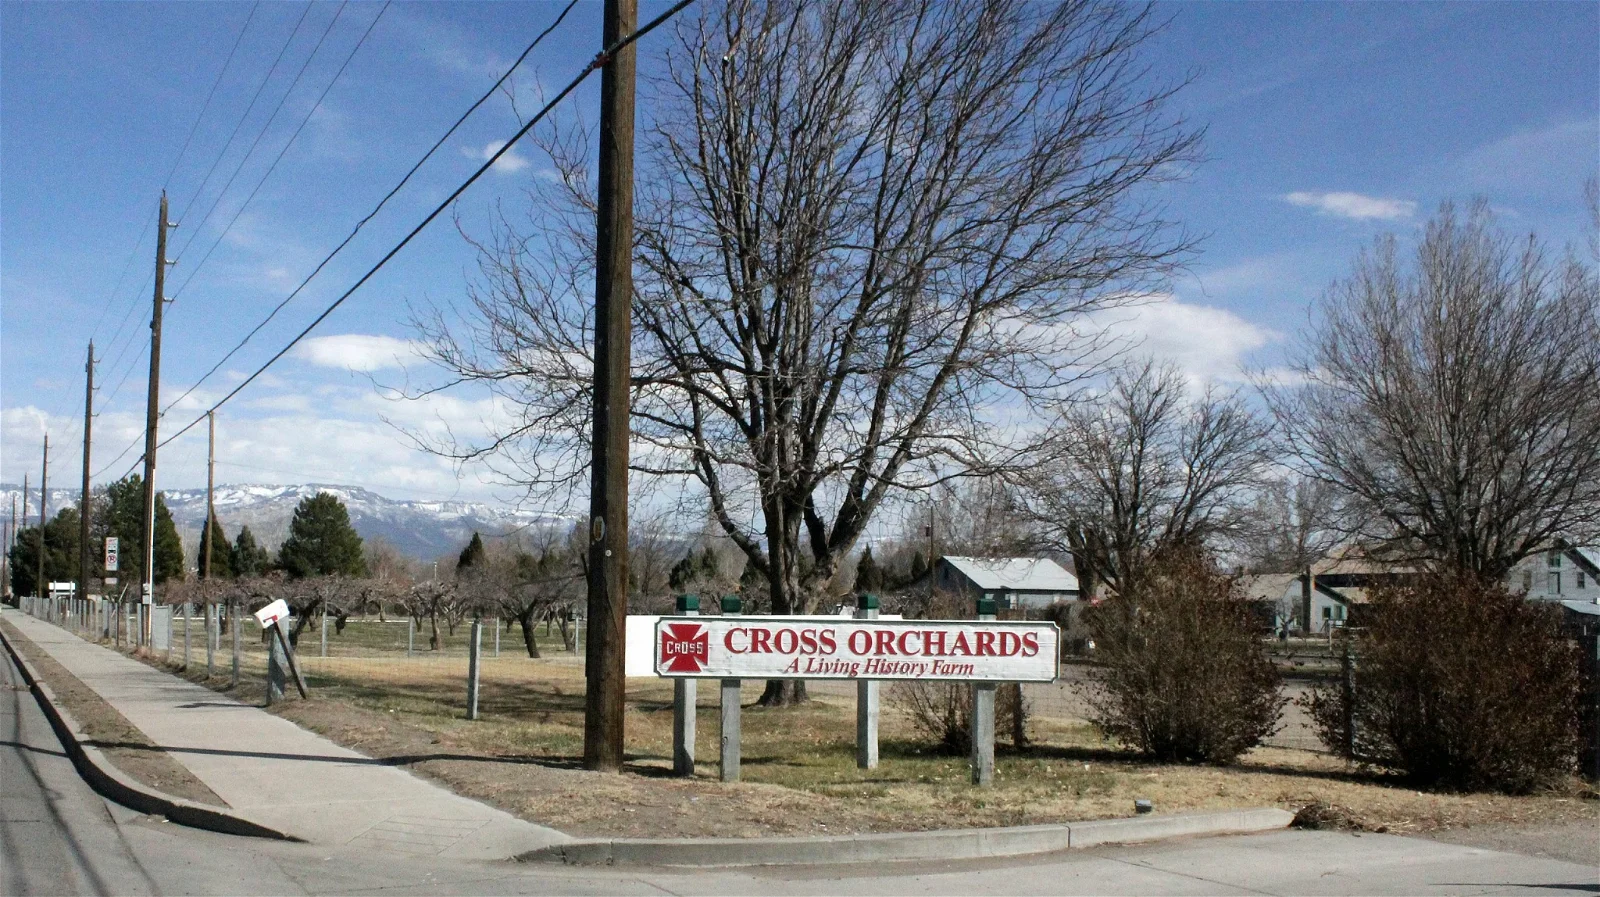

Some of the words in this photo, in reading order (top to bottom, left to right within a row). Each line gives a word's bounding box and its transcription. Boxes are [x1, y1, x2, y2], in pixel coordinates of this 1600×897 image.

[667, 641, 703, 654] CROSS
[724, 627, 837, 655] CROSS
[848, 629, 1039, 657] ORCHARDS
[785, 657, 799, 673] A
[804, 658, 859, 677] Living
[863, 658, 928, 677] History
[931, 659, 974, 675] Farm
